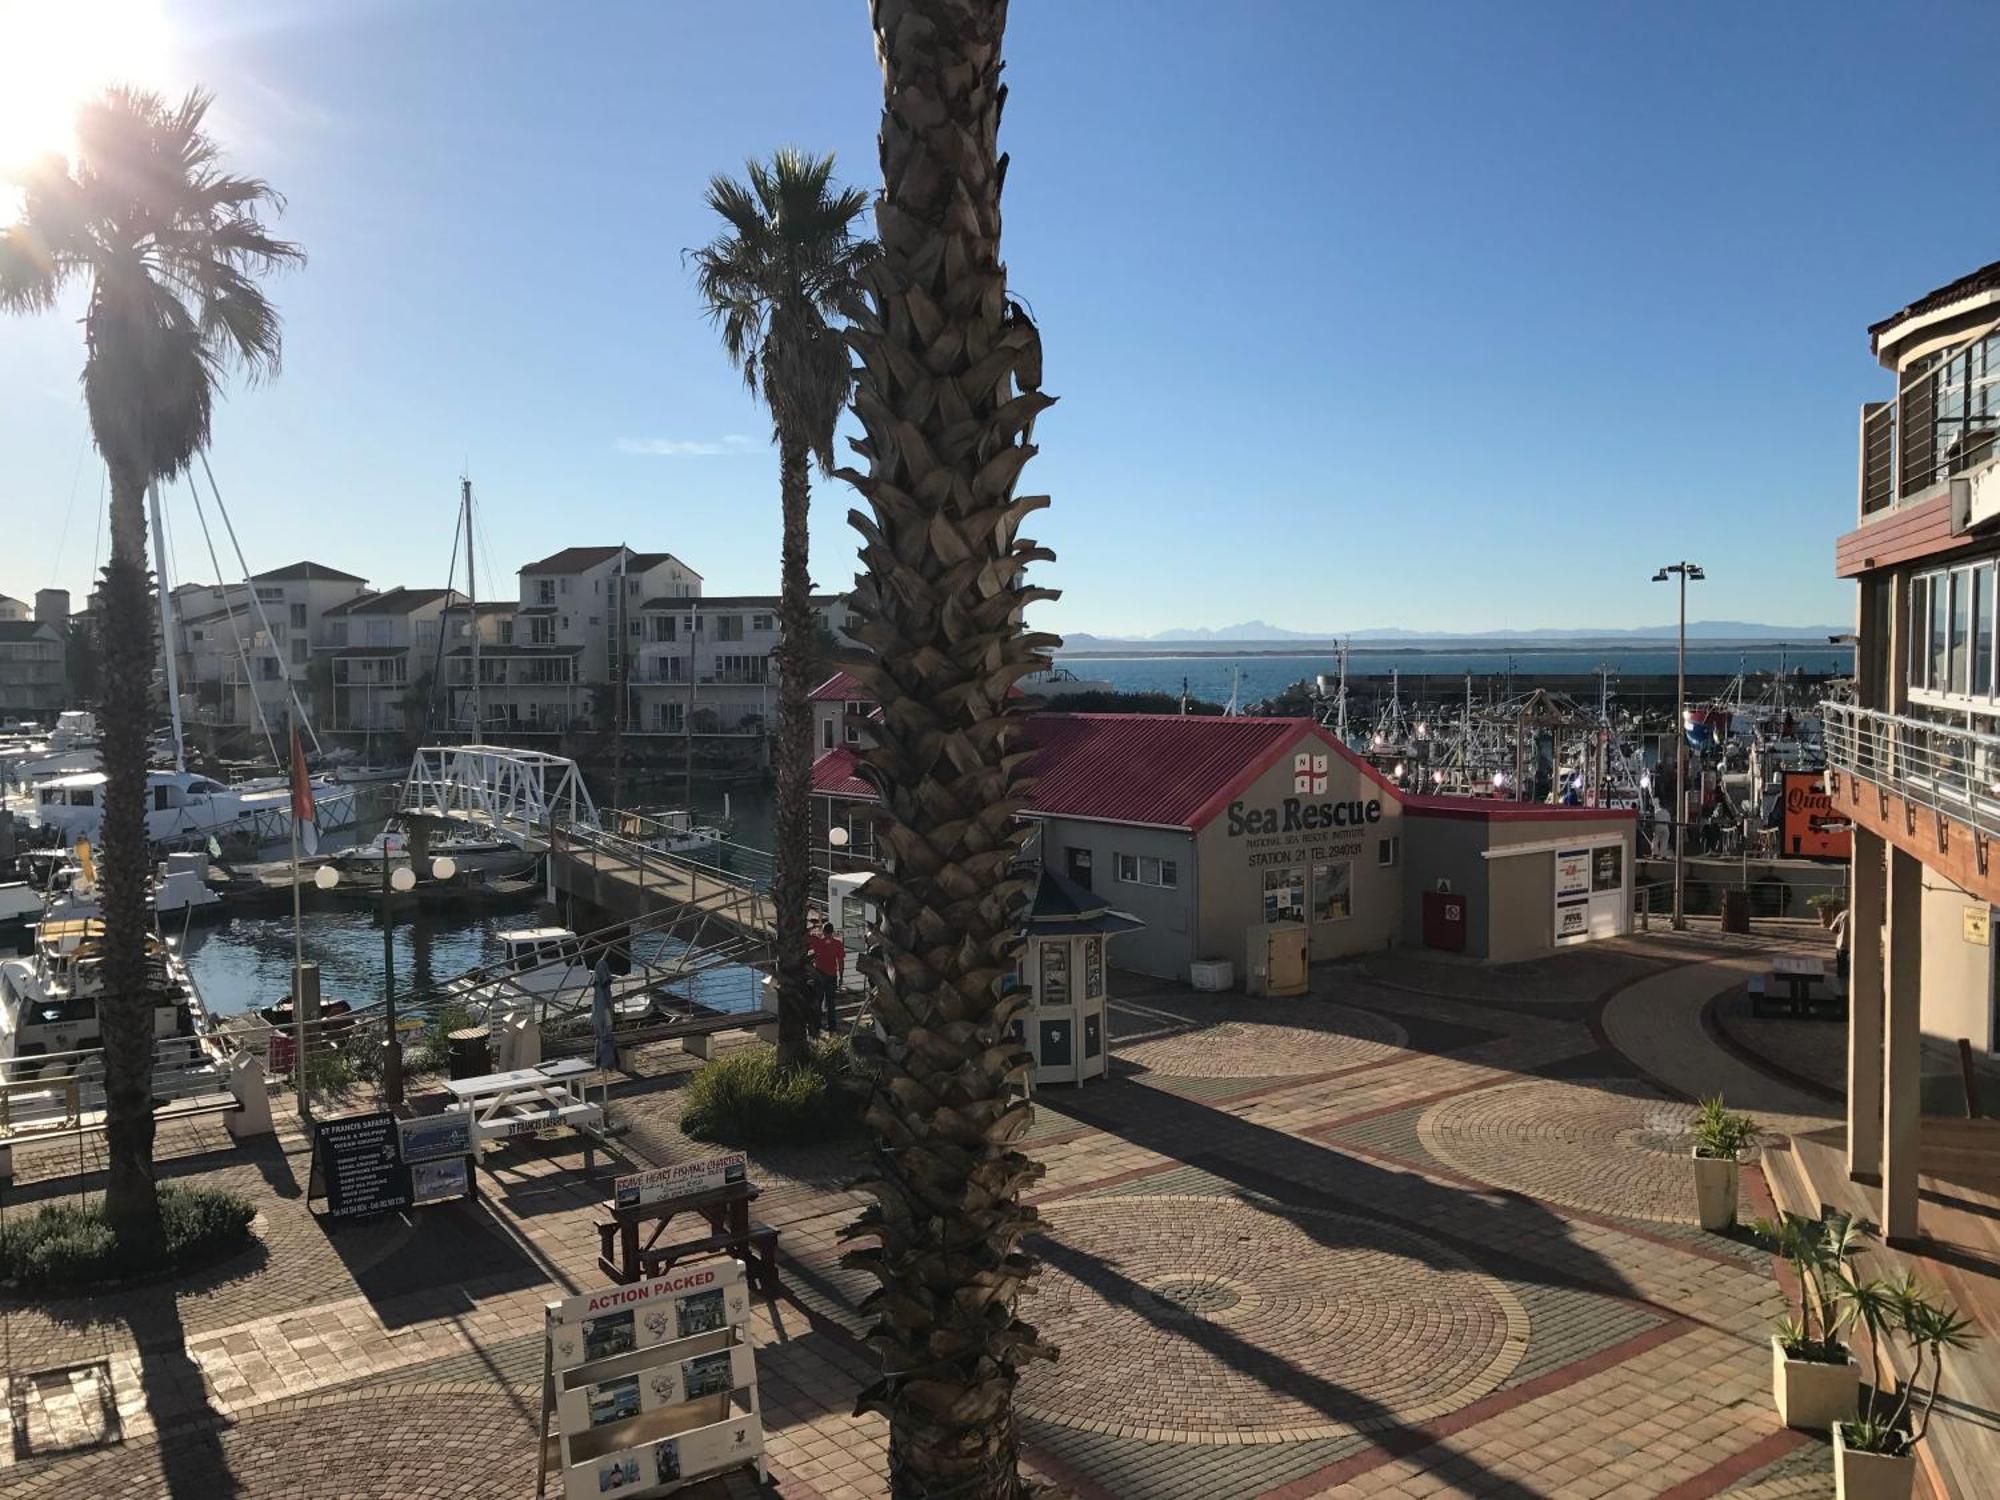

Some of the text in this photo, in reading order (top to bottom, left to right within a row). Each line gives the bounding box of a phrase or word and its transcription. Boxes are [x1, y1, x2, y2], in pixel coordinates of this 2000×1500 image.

[1299, 758, 1323, 769] N S
[1227, 798, 1381, 837] Sea Rescue
[1246, 836, 1281, 848] NATIONAL
[1302, 832, 1328, 844] RESCUE
[1248, 852, 1291, 867] STATION
[1295, 849, 1305, 861] 21
[331, 1122, 362, 1134] FRANCIS
[362, 1117, 391, 1129] SAFARIS
[646, 1169, 671, 1183] HEART
[673, 1162, 705, 1178] FISHING
[706, 1154, 746, 1170] CHARTERS
[588, 1271, 715, 1311] ACTION PACKED
